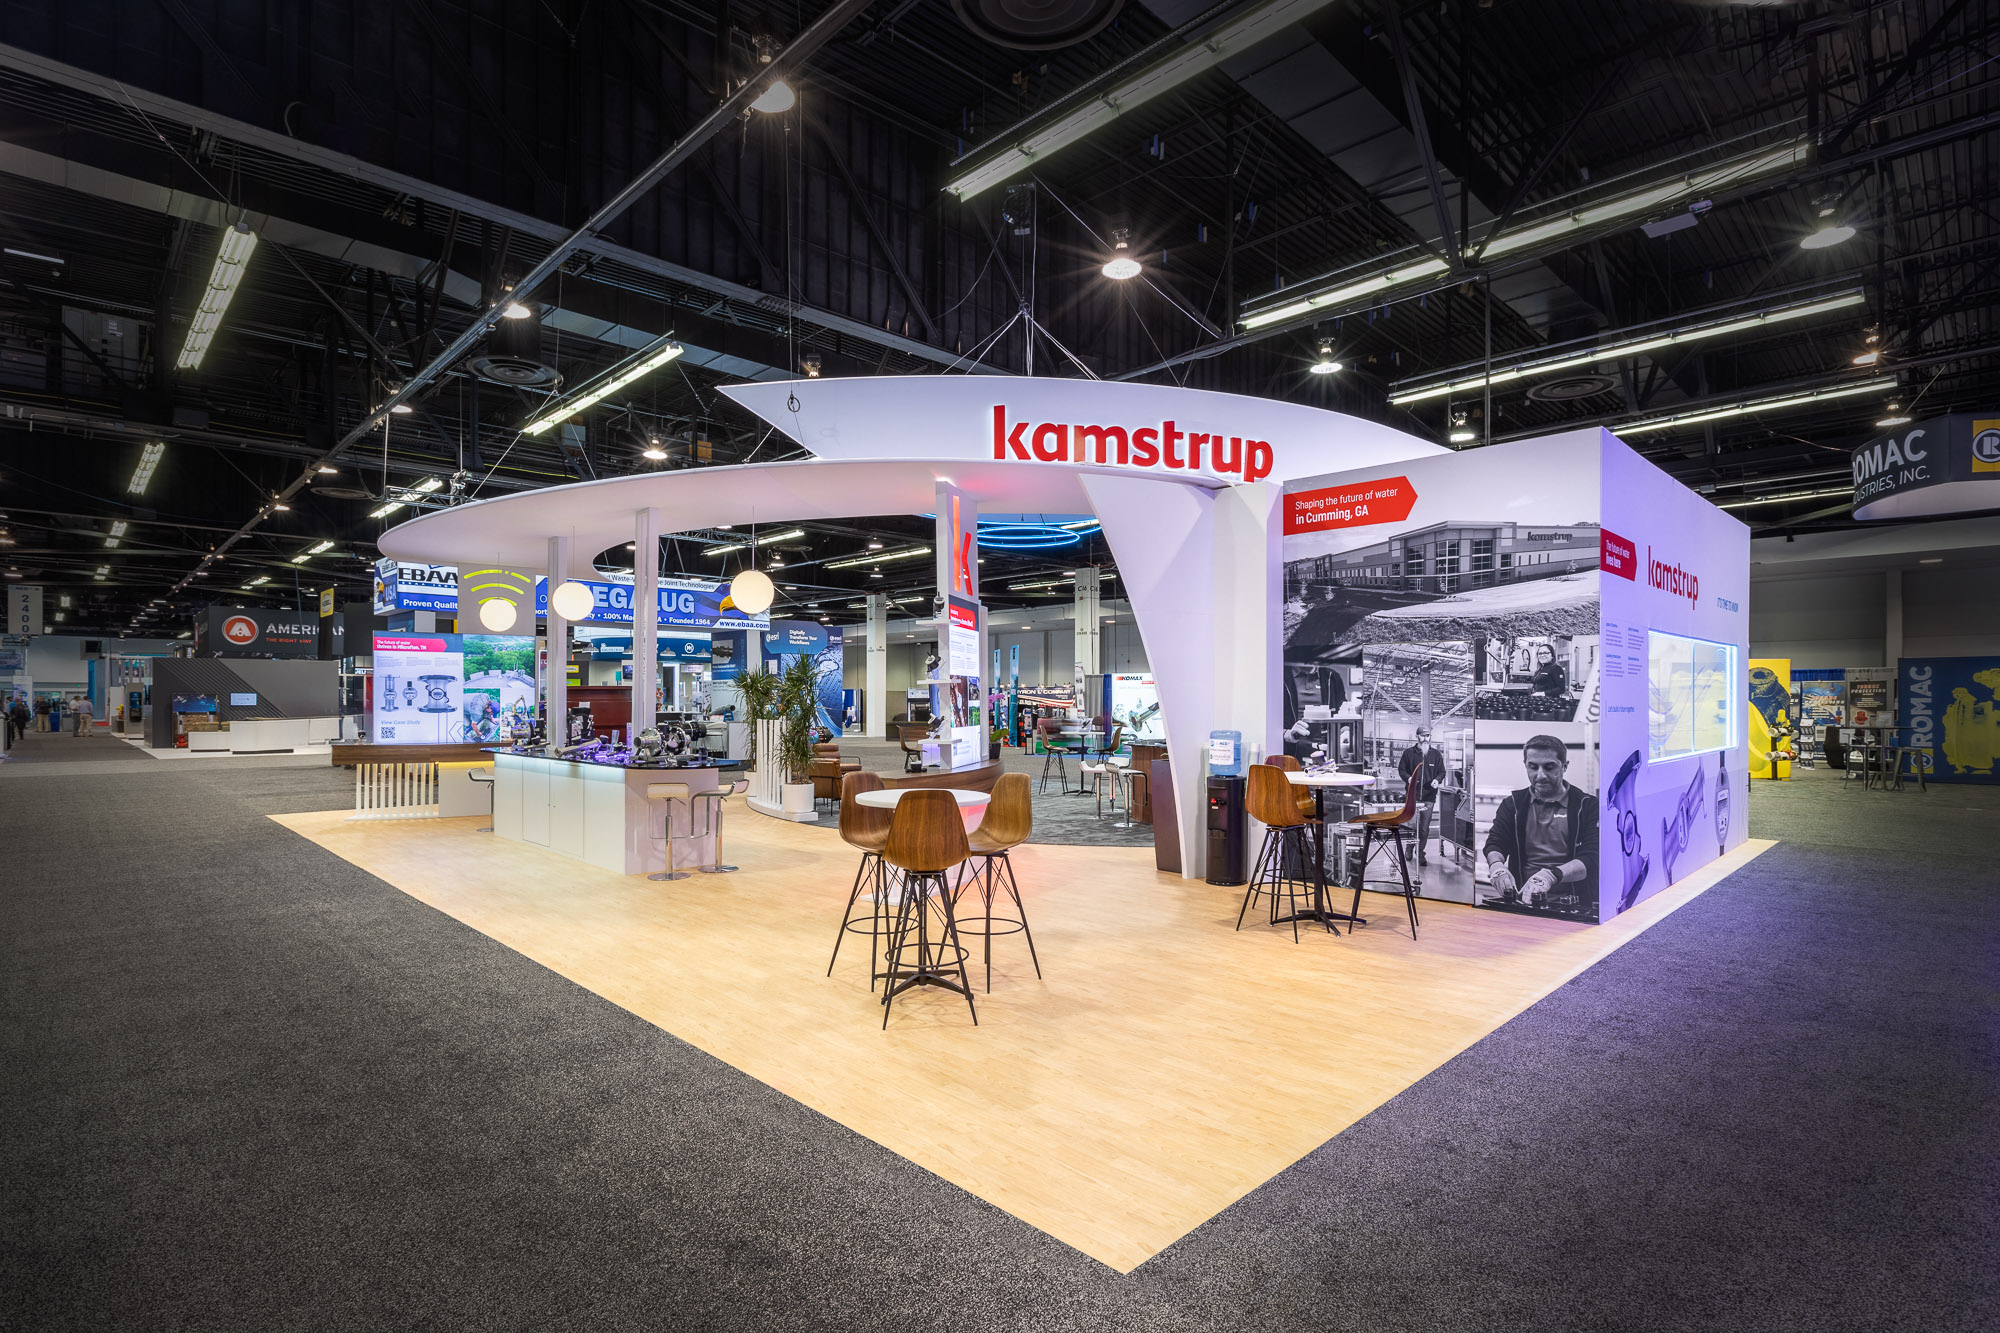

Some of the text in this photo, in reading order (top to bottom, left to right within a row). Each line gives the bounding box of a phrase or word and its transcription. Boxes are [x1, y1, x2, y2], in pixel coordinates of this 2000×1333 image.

[994, 405, 1274, 483] kamstrup
[1900, 466, 1930, 485] INC.
[1295, 488, 1399, 511] Shaping the future of water
[1296, 505, 1369, 525] in Cumming, GA
[1527, 531, 1573, 542] kamstrup
[398, 567, 458, 584] EBAA
[679, 580, 715, 590] Technologies
[1648, 545, 1699, 611] kamstrup
[403, 599, 432, 608] Proven
[22, 594, 30, 633] 2400
[603, 612, 621, 620] 100%
[669, 617, 694, 625] Founded
[719, 620, 770, 629] www.ebaa.com
[1909, 666, 1933, 749] ROMAC
